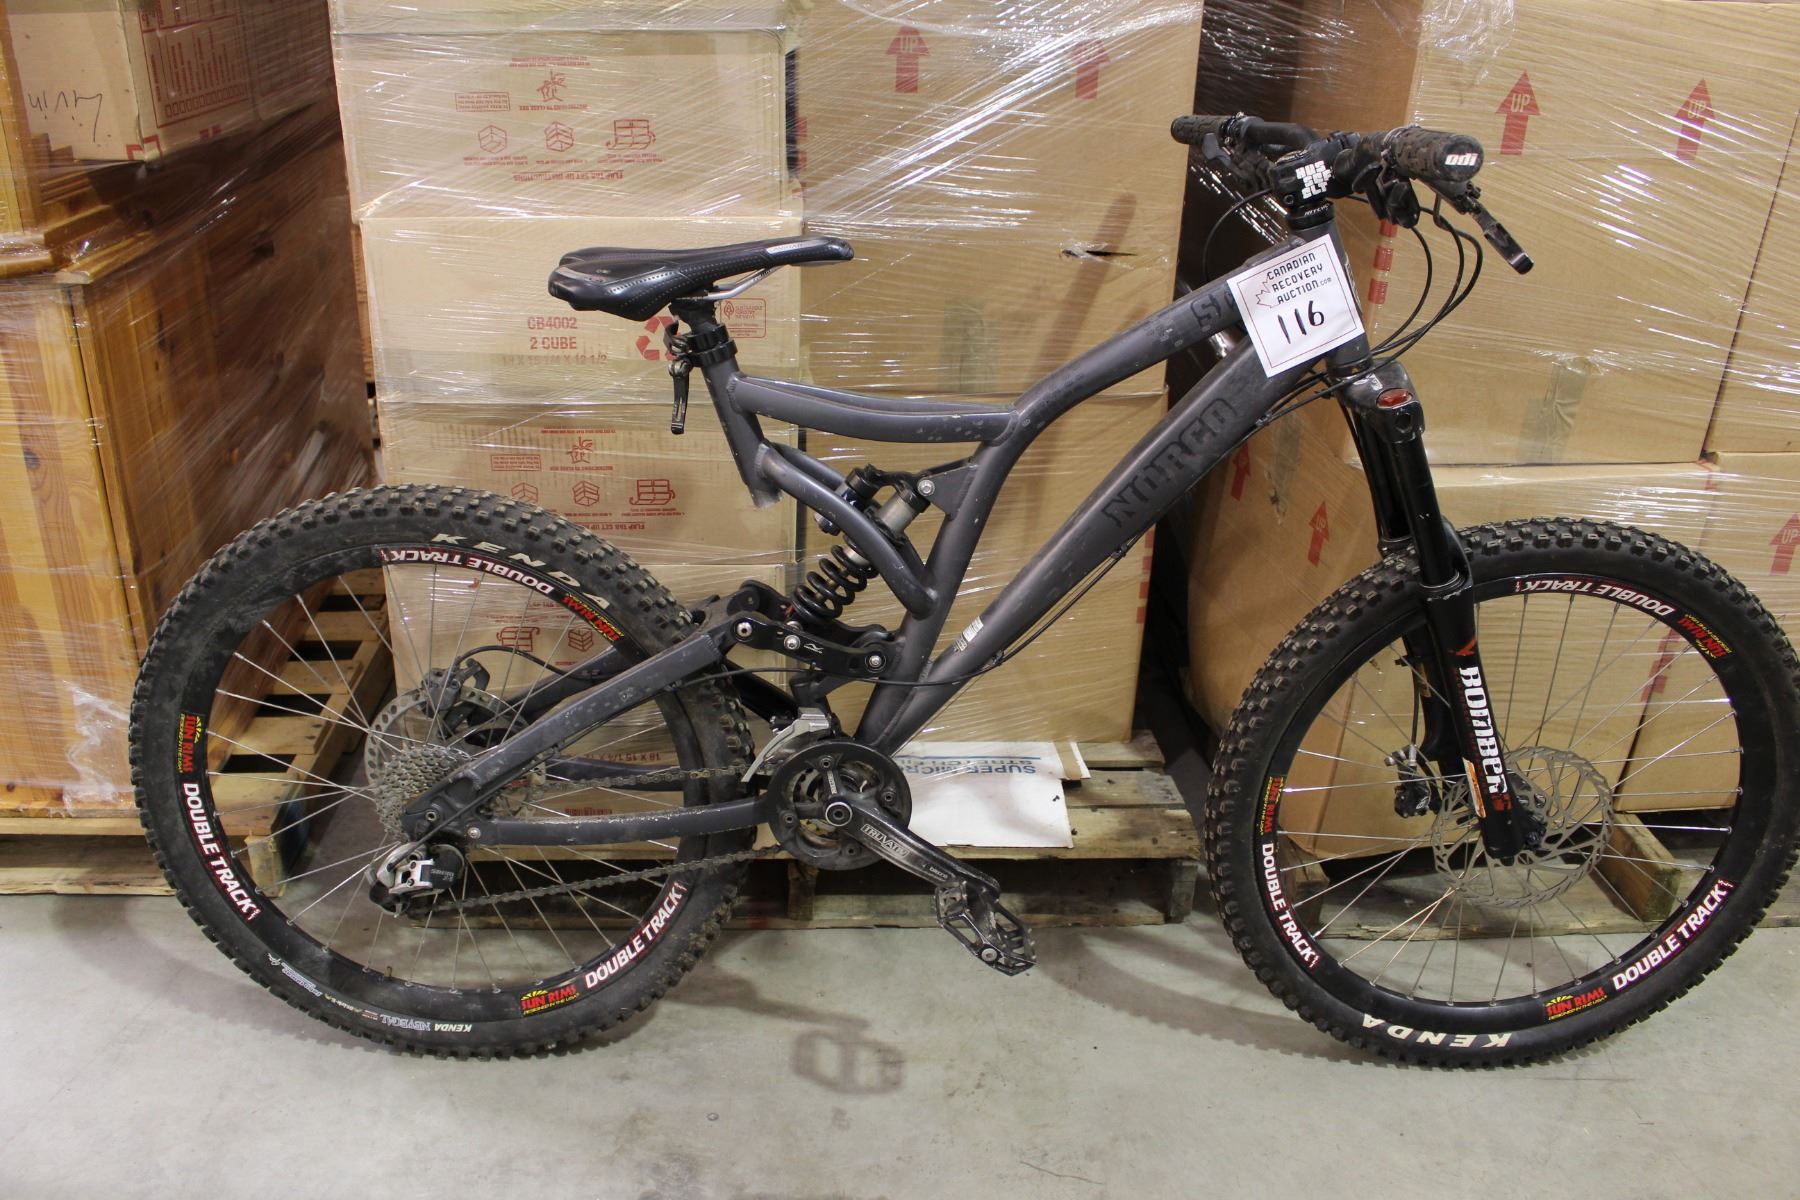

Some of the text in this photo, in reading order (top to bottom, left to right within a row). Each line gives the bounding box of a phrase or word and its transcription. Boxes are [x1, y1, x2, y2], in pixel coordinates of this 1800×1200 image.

[1511, 93, 1530, 113] UP
[1687, 100, 1706, 119] UP
[1445, 153, 1478, 167] odi
[1267, 252, 1316, 280] CANADIAN
[1272, 263, 1324, 293] RECOVERY
[527, 316, 578, 330] CB4002
[1277, 300, 1325, 345] 116
[530, 336, 577, 350] 2 CUBE
[1781, 528, 1799, 545] UP
[431, 533, 611, 610] KENDA
[467, 556, 555, 595] DOUBLE
[1597, 584, 1676, 617] DOUBLE
[183, 715, 197, 773] SUN RIMS
[1458, 666, 1509, 796] BOMBER
[967, 764, 1037, 774] SUPER
[183, 783, 219, 862] DOUBLE
[1262, 843, 1285, 913] DOUBLE
[585, 935, 645, 989] DOUBLE
[1612, 933, 1682, 991] DOUBLE
[521, 986, 577, 1010] SUN RIMS
[1545, 987, 1605, 1017] SUN RIMS
[434, 1023, 473, 1033] KENDA
[1362, 1013, 1513, 1048] KENDA
